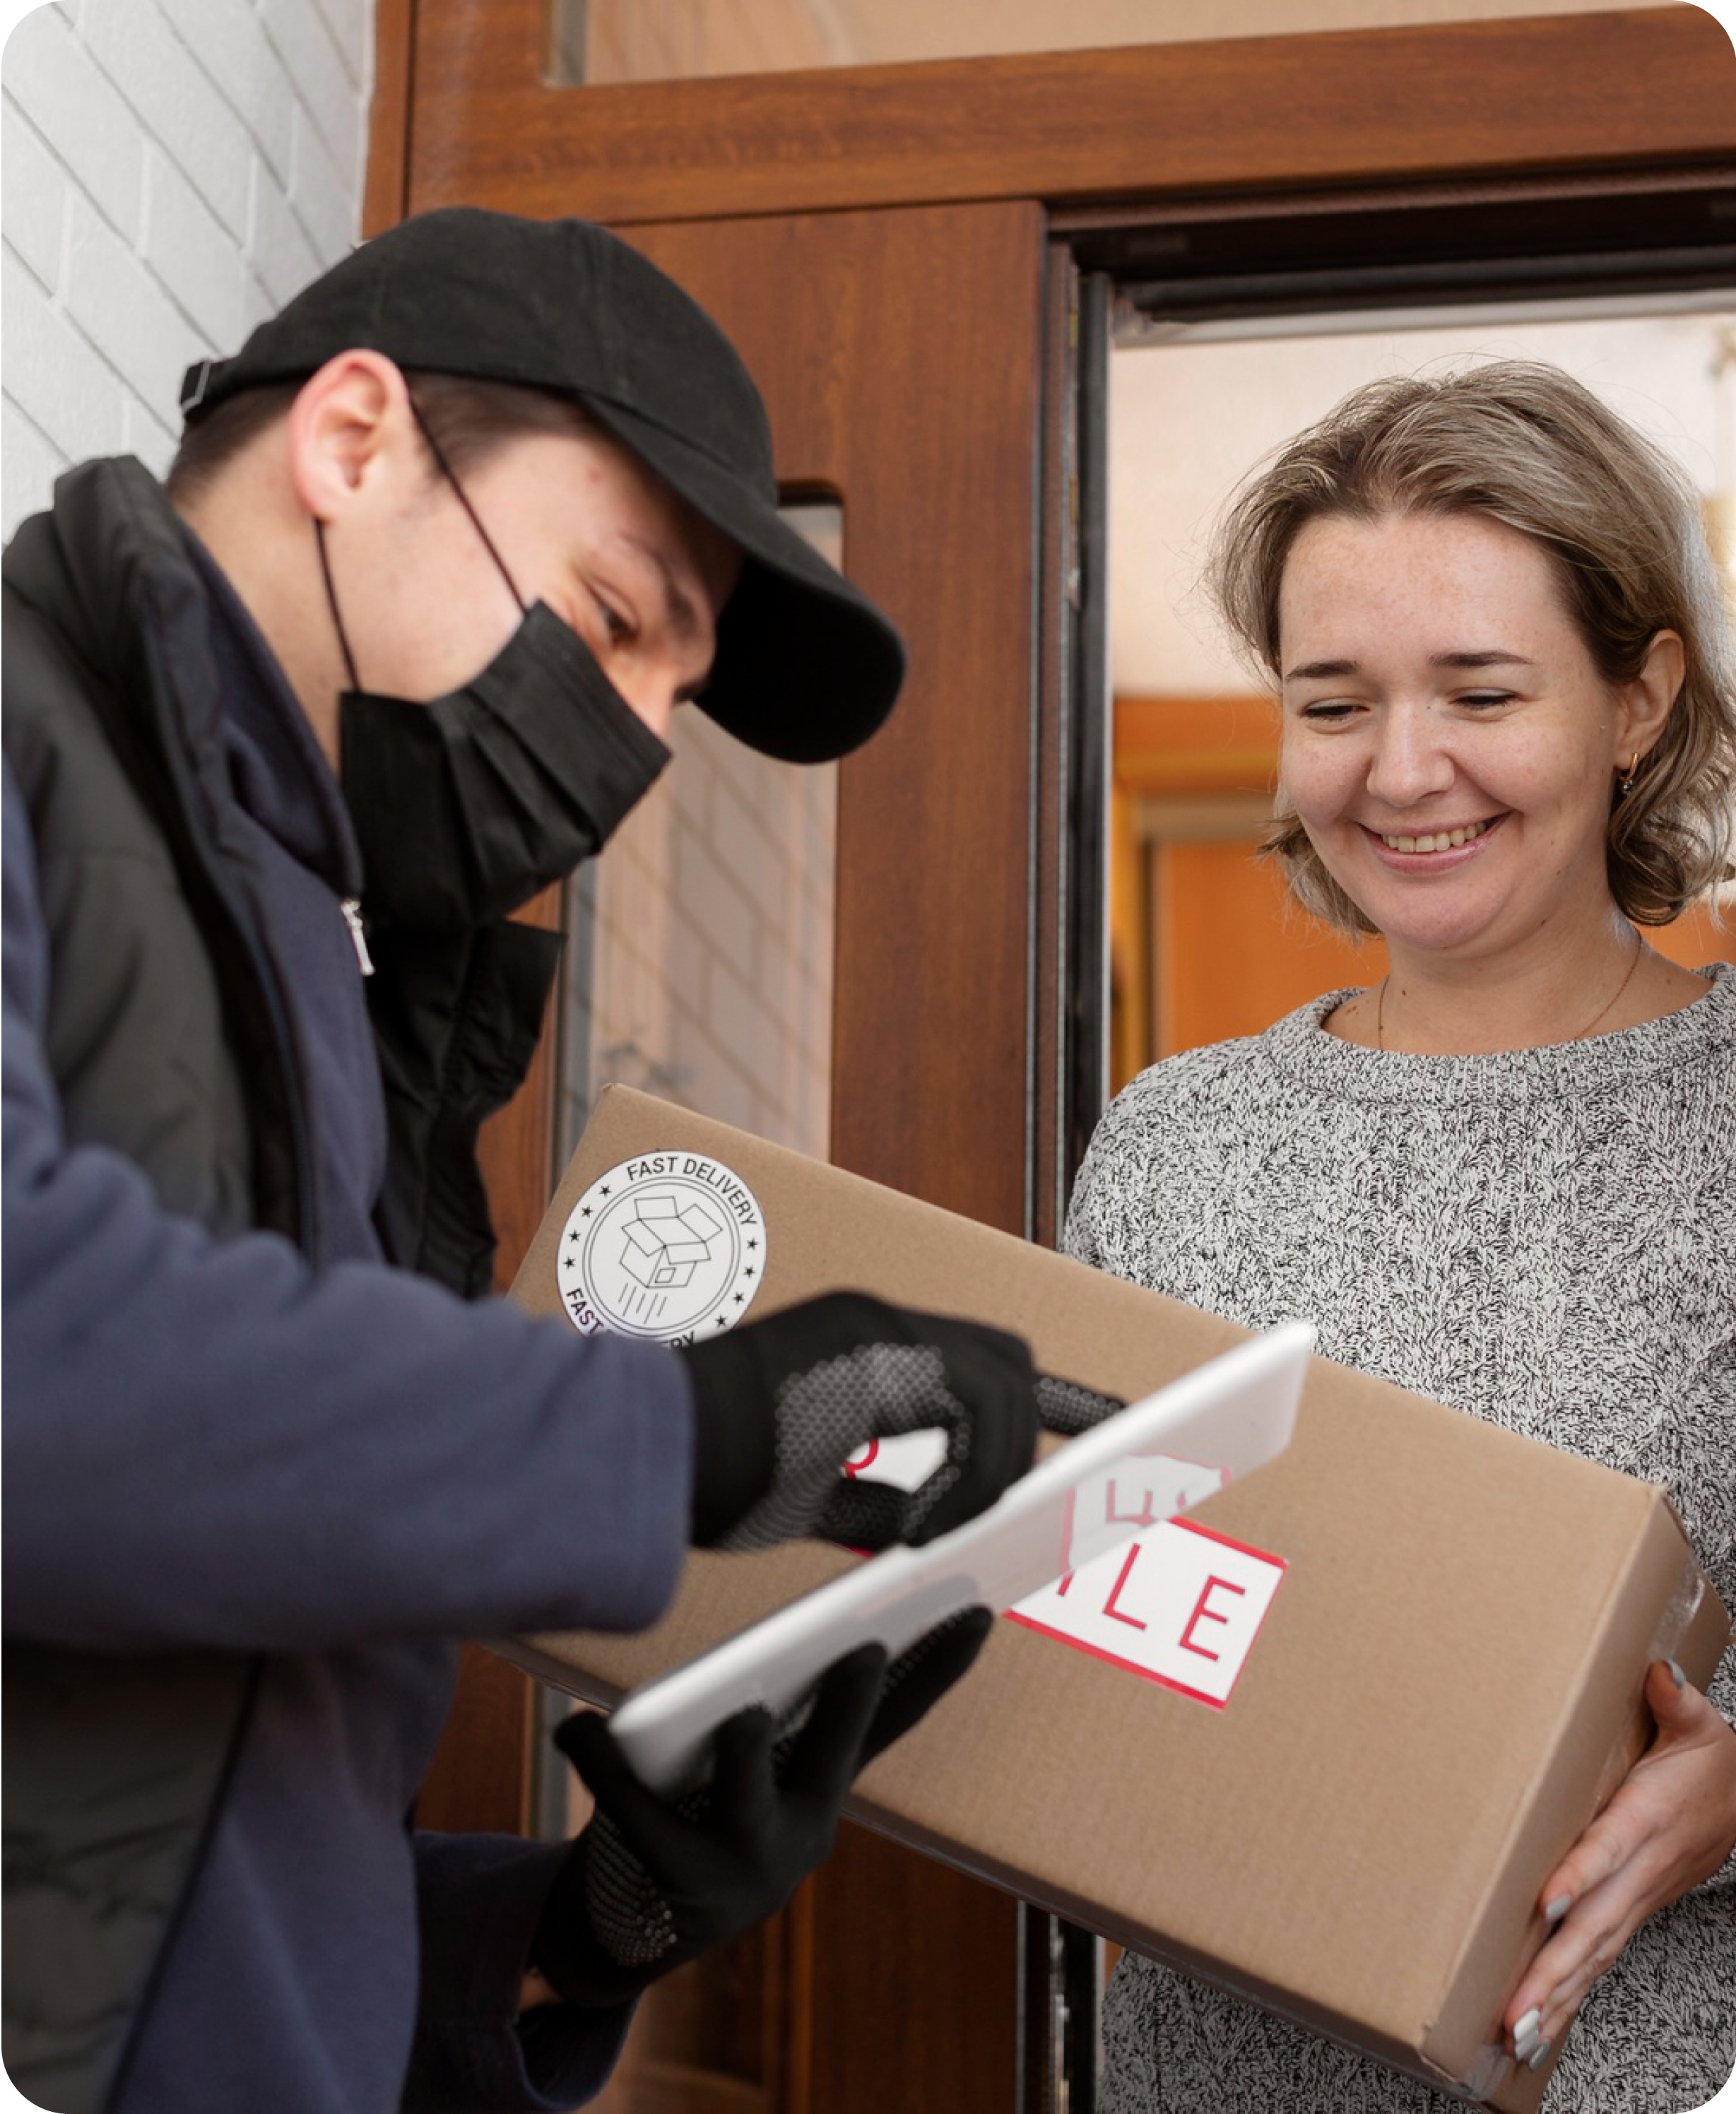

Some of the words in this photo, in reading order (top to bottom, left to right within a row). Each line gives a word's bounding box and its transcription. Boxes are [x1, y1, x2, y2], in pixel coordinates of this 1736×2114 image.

[627, 1157, 678, 1180] FAST
[683, 1158, 757, 1225] DELIVERY
[566, 1287, 604, 1335] FAST
